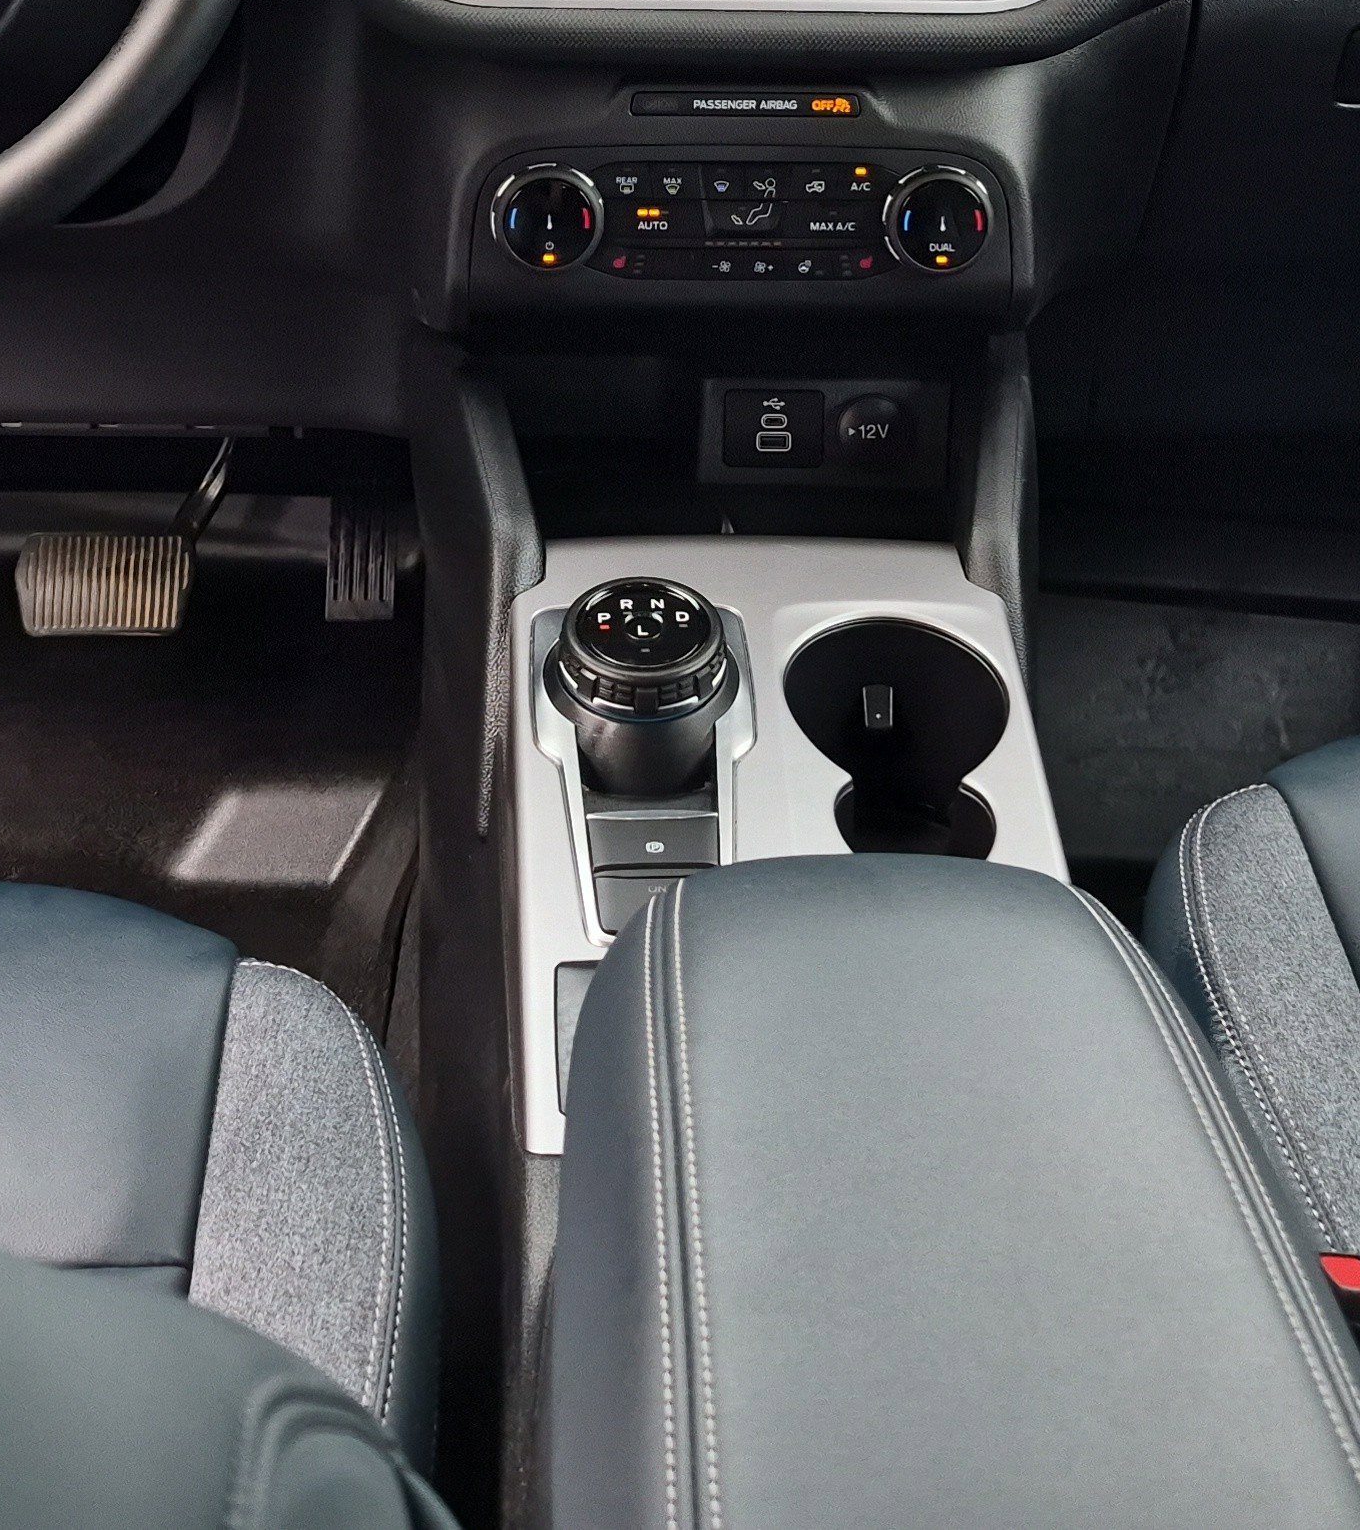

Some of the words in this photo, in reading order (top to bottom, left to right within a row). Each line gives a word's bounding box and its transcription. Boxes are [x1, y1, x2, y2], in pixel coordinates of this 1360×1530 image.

[693, 99, 756, 110] PASSENGER
[759, 100, 798, 110] AIRBAG
[811, 99, 835, 112] OFF
[615, 176, 638, 184] REAR
[850, 182, 871, 191] A/C
[637, 221, 668, 230] AUTO
[810, 222, 834, 231] MAX
[835, 222, 856, 232] A/C
[929, 243, 955, 252] DUAL
[858, 423, 890, 440] 12V
[597, 612, 612, 623] P
[620, 598, 634, 610] R
[650, 598, 665, 609] N
[675, 611, 690, 622] D
[637, 624, 649, 636] L
